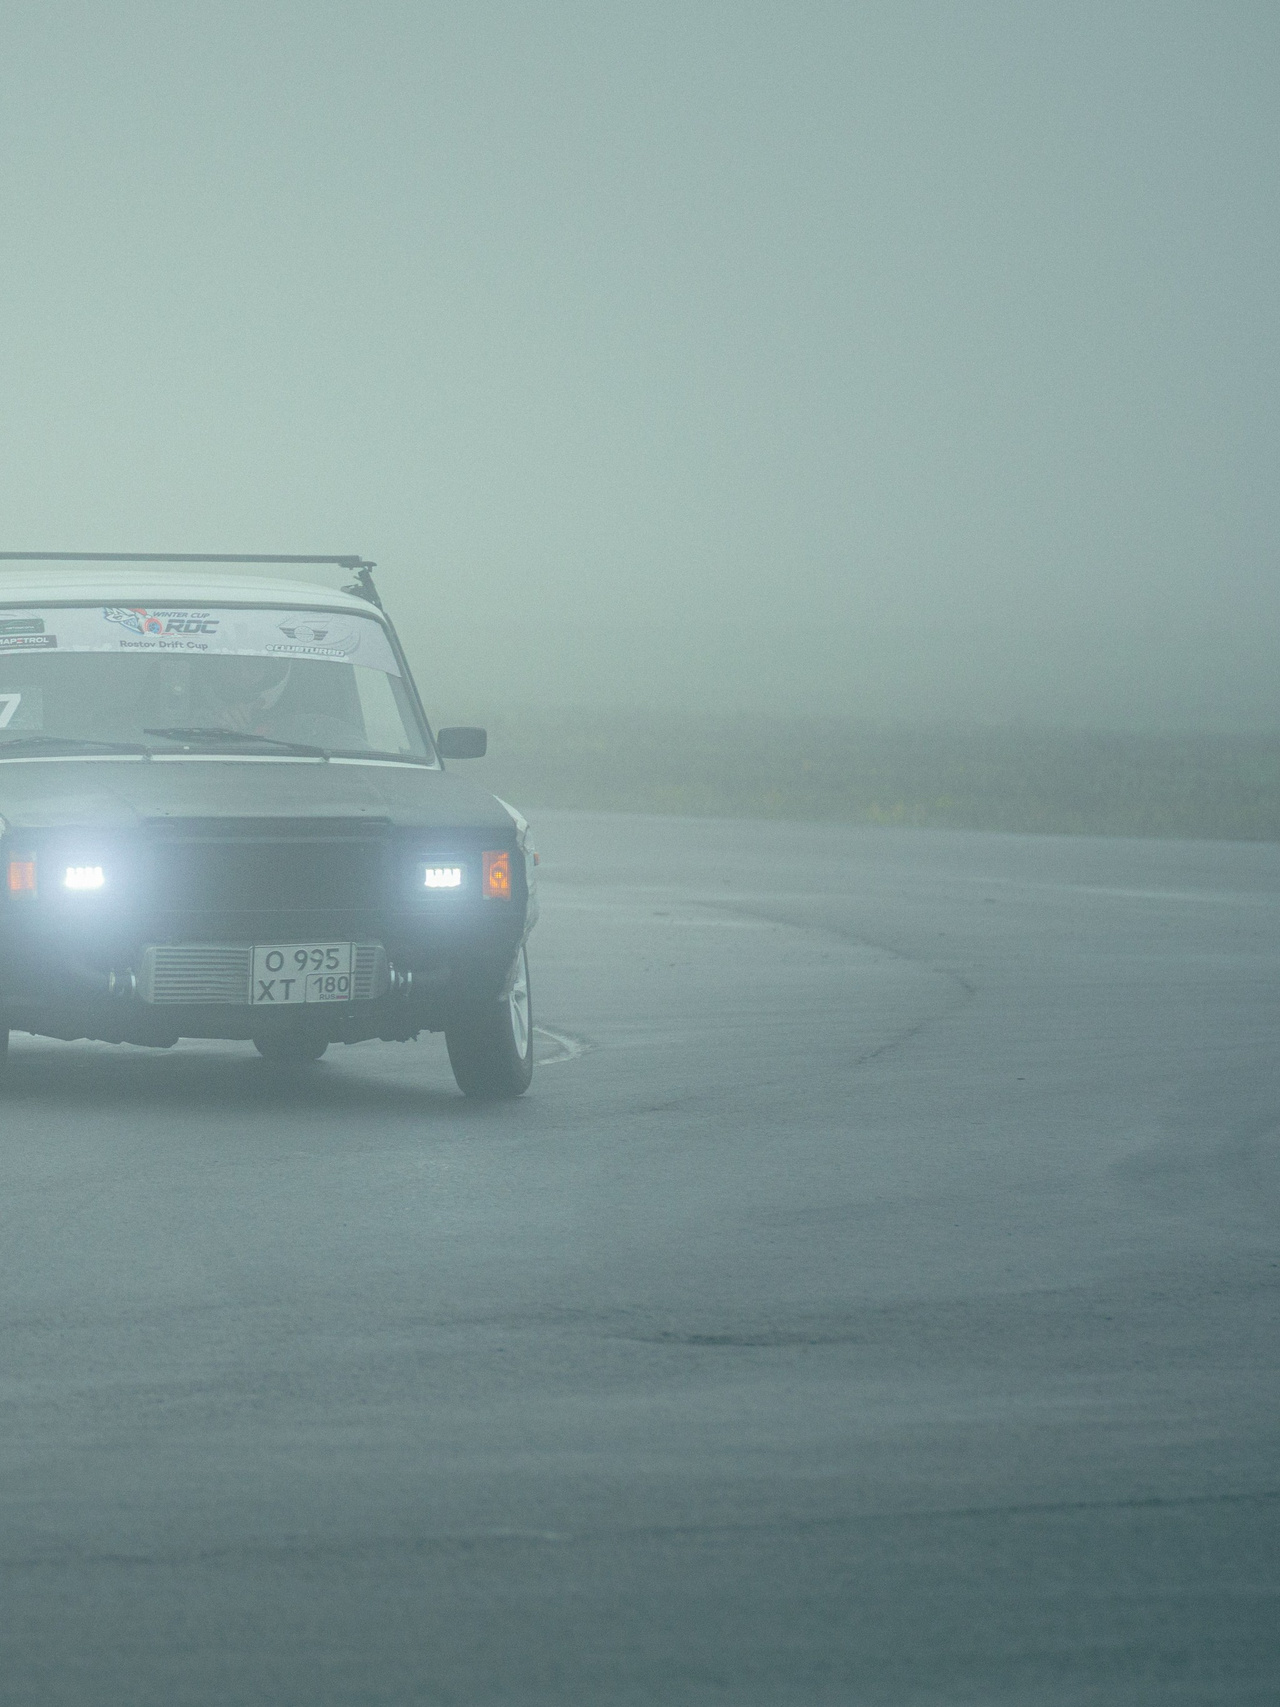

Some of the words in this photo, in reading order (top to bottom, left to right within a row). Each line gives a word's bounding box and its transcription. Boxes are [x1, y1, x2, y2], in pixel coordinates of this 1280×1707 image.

[165, 619, 219, 634] RDC
[120, 640, 156, 648] Rostov
[159, 640, 184, 648] Drift
[186, 641, 208, 651] Cup
[294, 948, 339, 971] 995
[313, 976, 349, 993] 180
